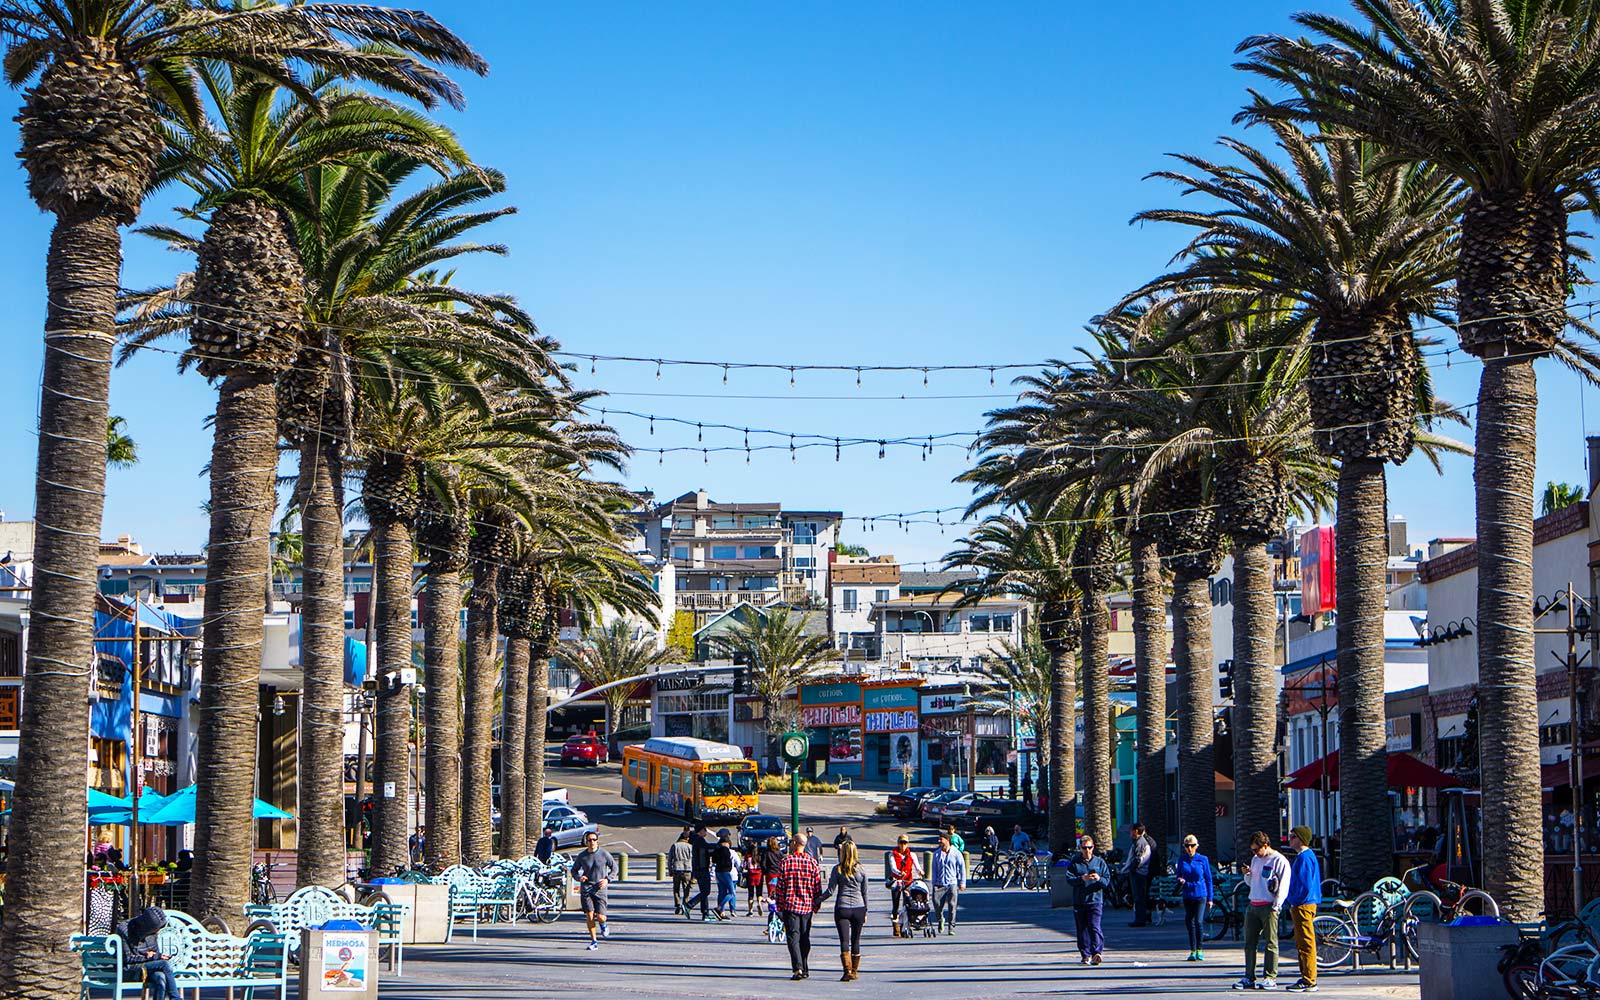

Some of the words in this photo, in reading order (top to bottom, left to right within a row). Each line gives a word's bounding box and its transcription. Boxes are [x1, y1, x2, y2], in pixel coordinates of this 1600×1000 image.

[818, 688, 844, 699] curious
[707, 745, 731, 754] Local
[326, 940, 365, 948] HERMOSA
